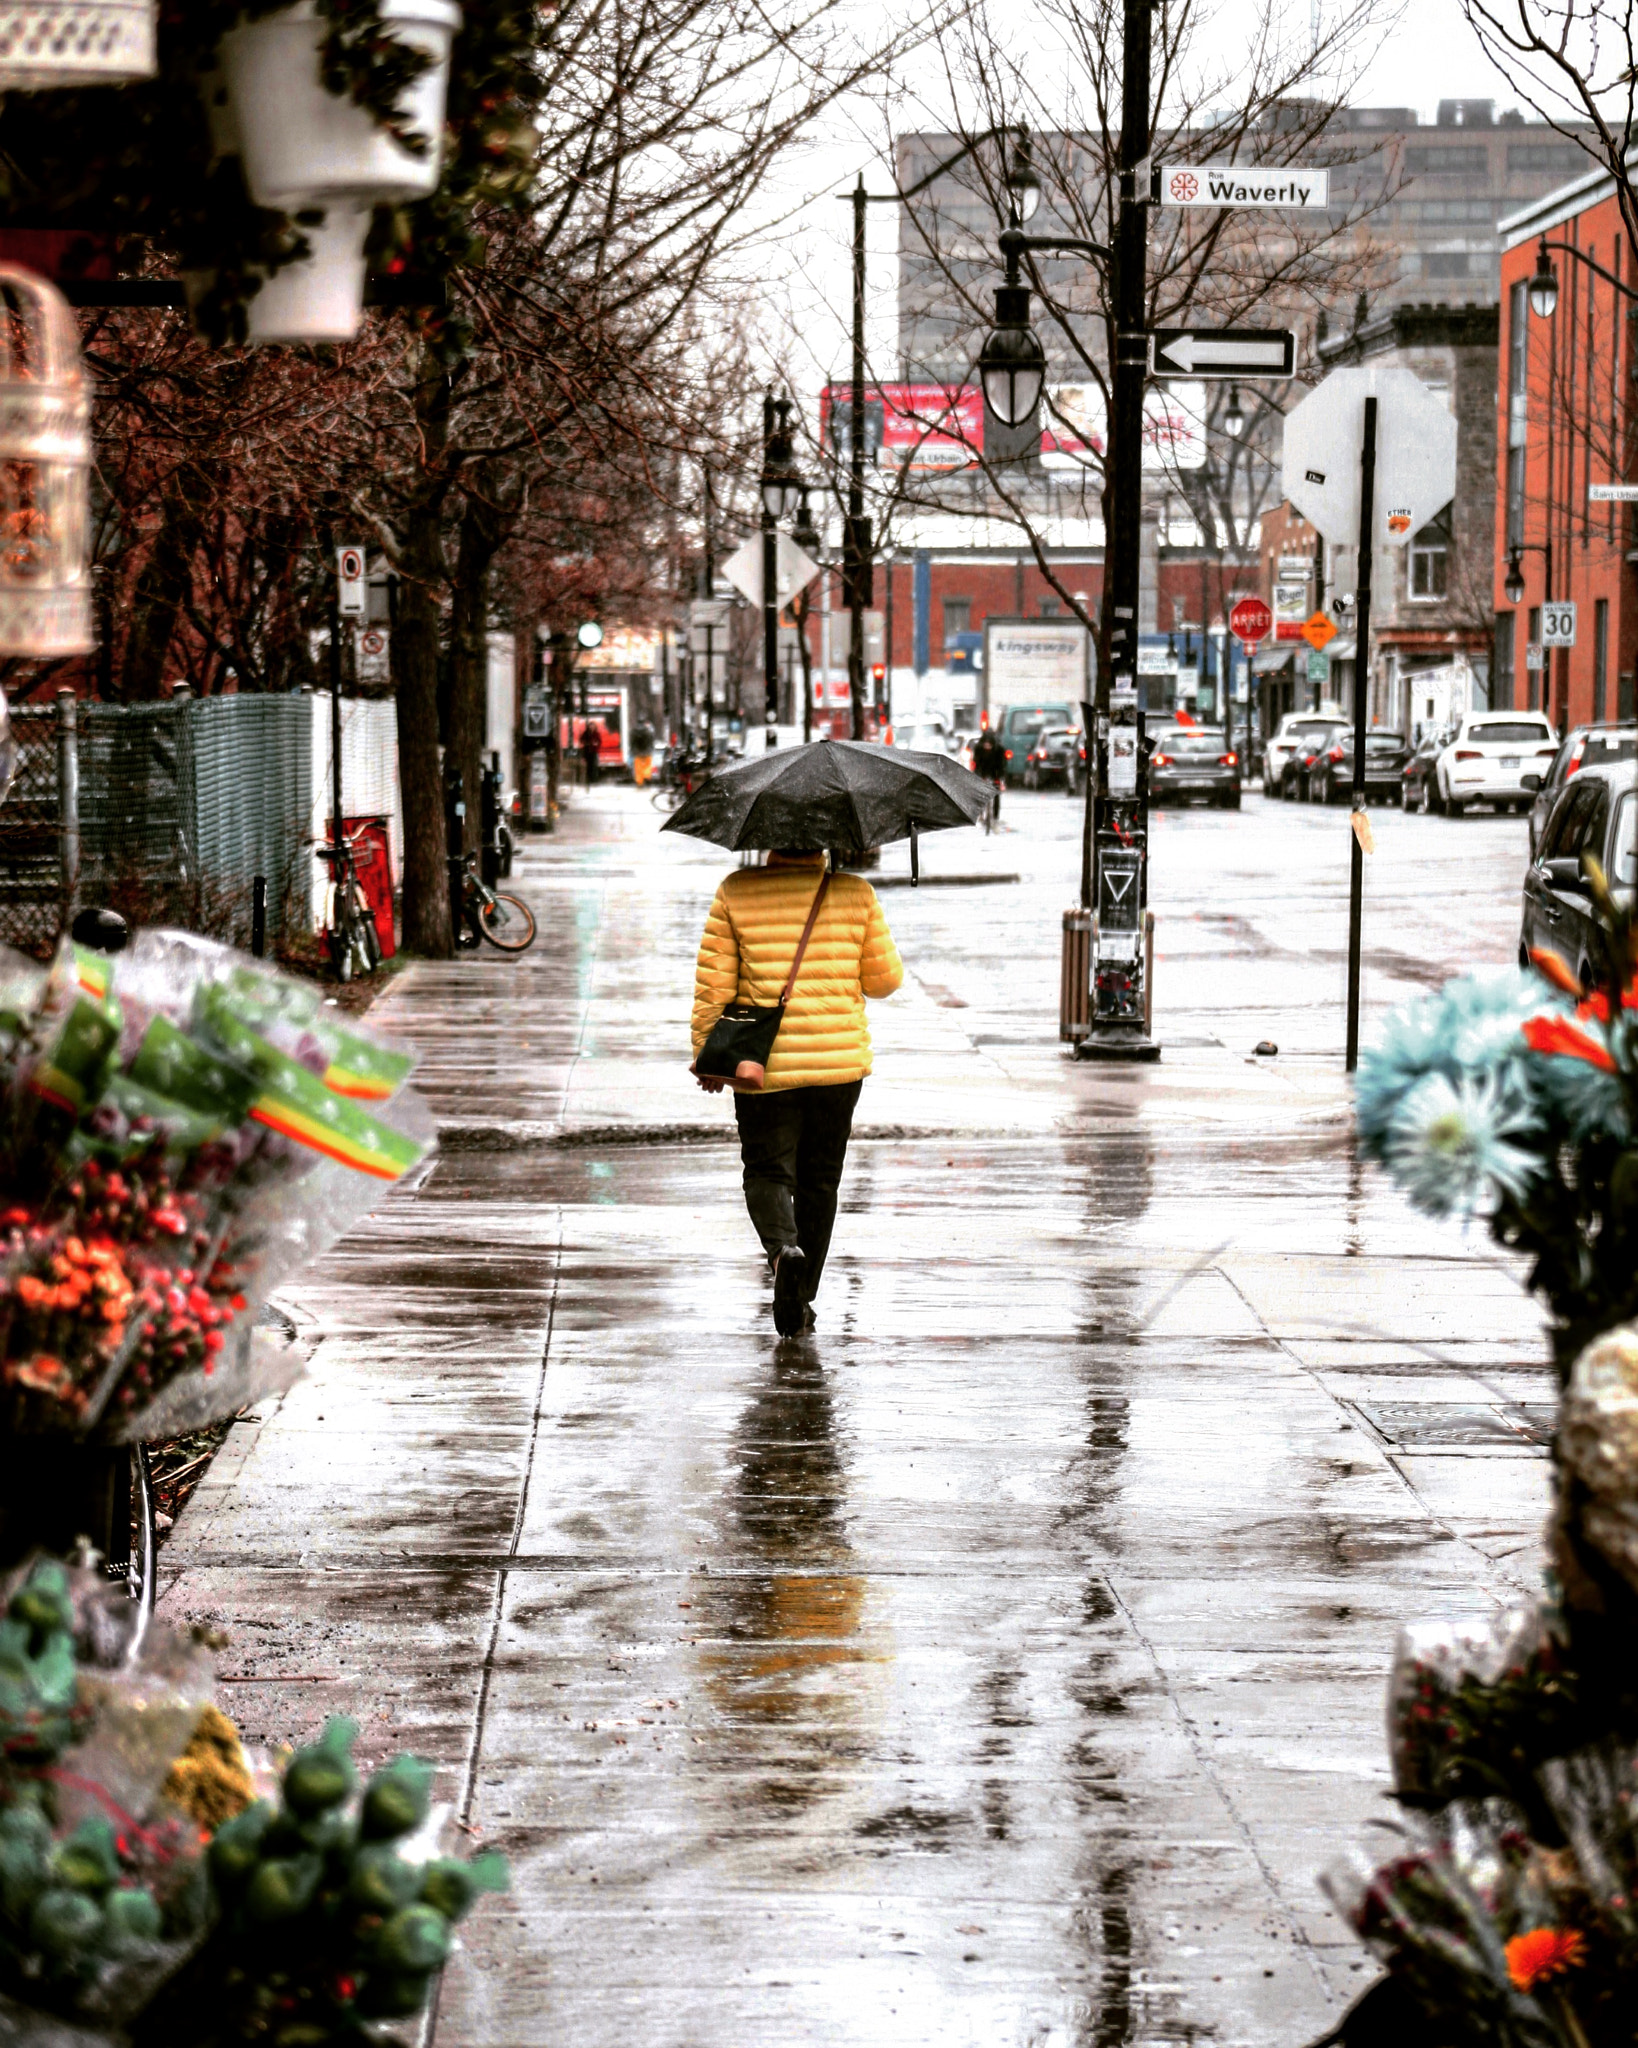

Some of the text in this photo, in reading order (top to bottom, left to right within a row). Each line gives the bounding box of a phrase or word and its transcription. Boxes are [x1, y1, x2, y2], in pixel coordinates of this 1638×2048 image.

[1208, 172, 1224, 180] Rue
[1208, 181, 1311, 206] Waverly
[1233, 613, 1270, 628] ARRÊT
[1545, 613, 1573, 636] 30
[996, 640, 1078, 655] kingsway
